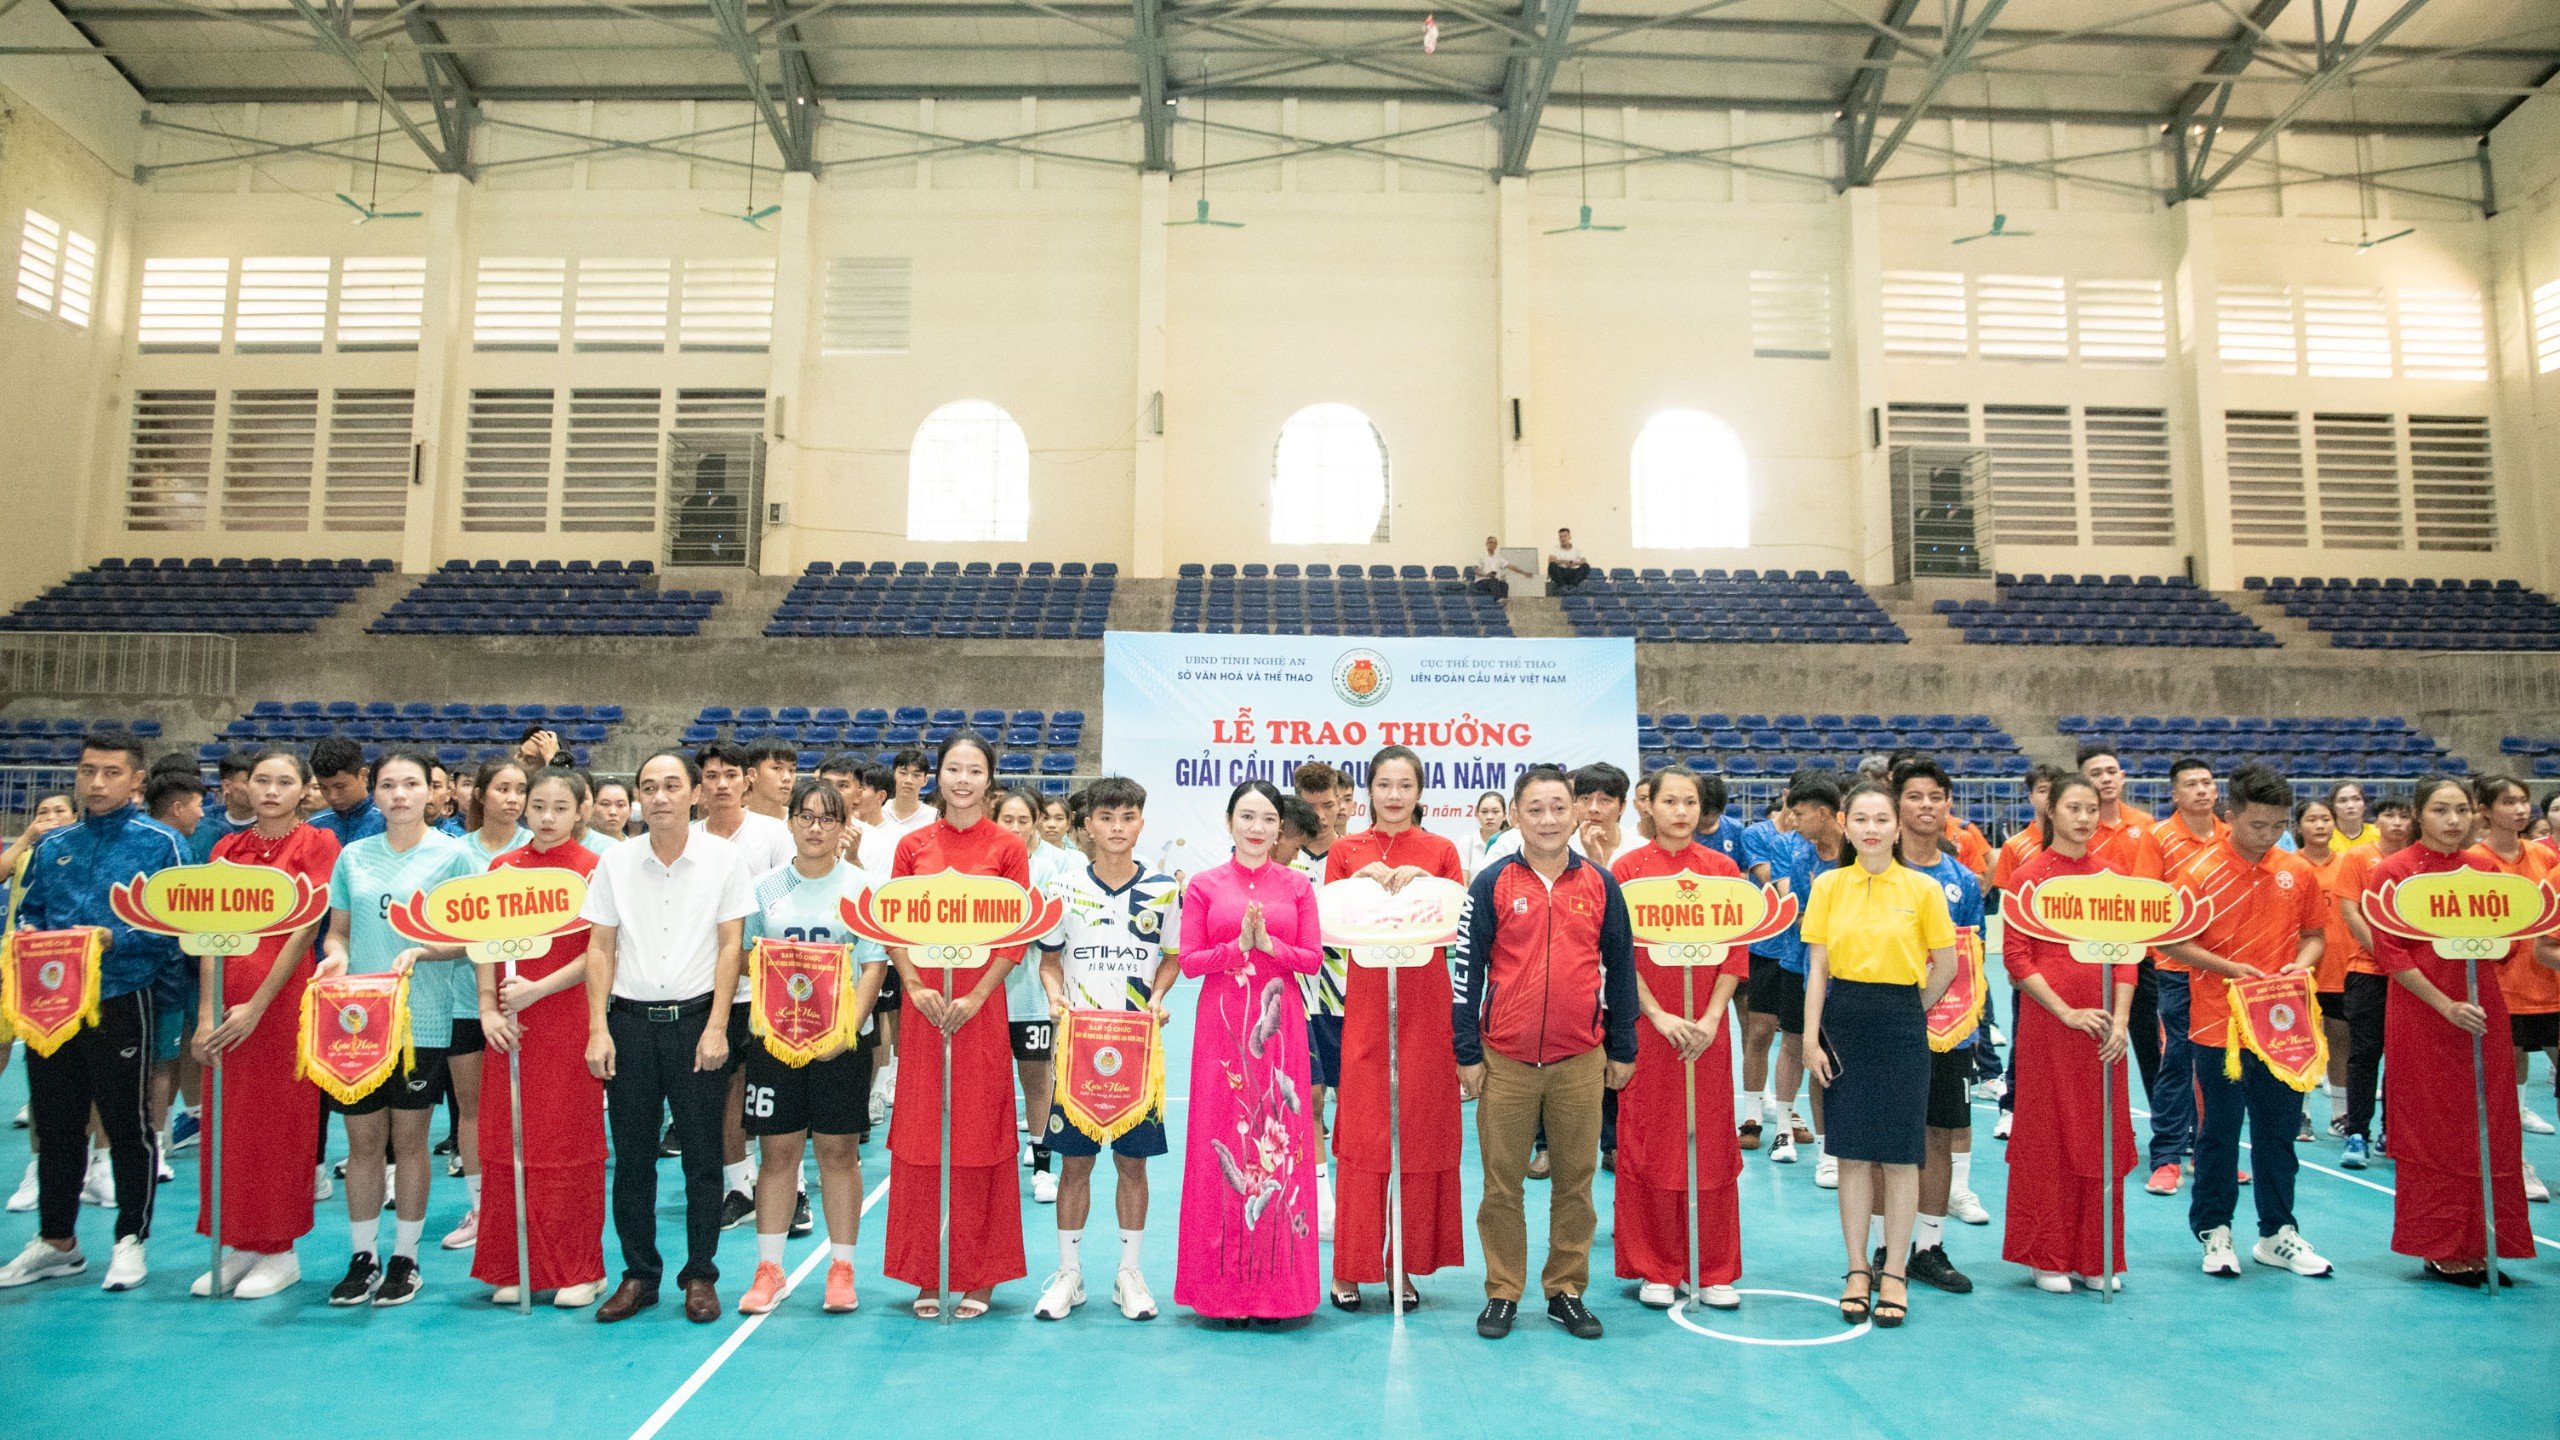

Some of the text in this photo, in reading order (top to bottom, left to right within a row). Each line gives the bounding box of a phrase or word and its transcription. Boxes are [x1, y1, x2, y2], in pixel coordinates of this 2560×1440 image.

[1185, 656, 1218, 665] UBND
[1289, 657, 1306, 667] AN
[1524, 660, 1556, 669] THAO
[1285, 673, 1313, 682] THAO
[1410, 671, 1431, 683] LIÊN
[1543, 675, 1567, 684] NAM
[1212, 706, 1532, 747] LỄ TRAO THƯỞNG
[1175, 749, 1221, 787] GIẢI
[1229, 749, 1274, 787] CẦU
[1424, 762, 1446, 789] IA
[1454, 756, 1506, 789] NĂM
[1432, 804, 1462, 817] năm
[166, 883, 274, 912] VĨNH LONG
[445, 886, 570, 923] SÓC TRĂNG
[880, 890, 1022, 923] TP HỒ CHÍ MINH
[2041, 891, 2173, 923] THỪA THIÊN HUẾ
[2429, 889, 2510, 923] HÀ NỘI
[1634, 898, 1743, 932] TRỌNG TÀI
[1073, 945, 1148, 961] ETIHAD
[1452, 893, 1475, 1005] VIETNAM
[1088, 962, 1138, 973] AIRWAYS
[1025, 1025, 1051, 1050] 30
[745, 1083, 775, 1118] 26
